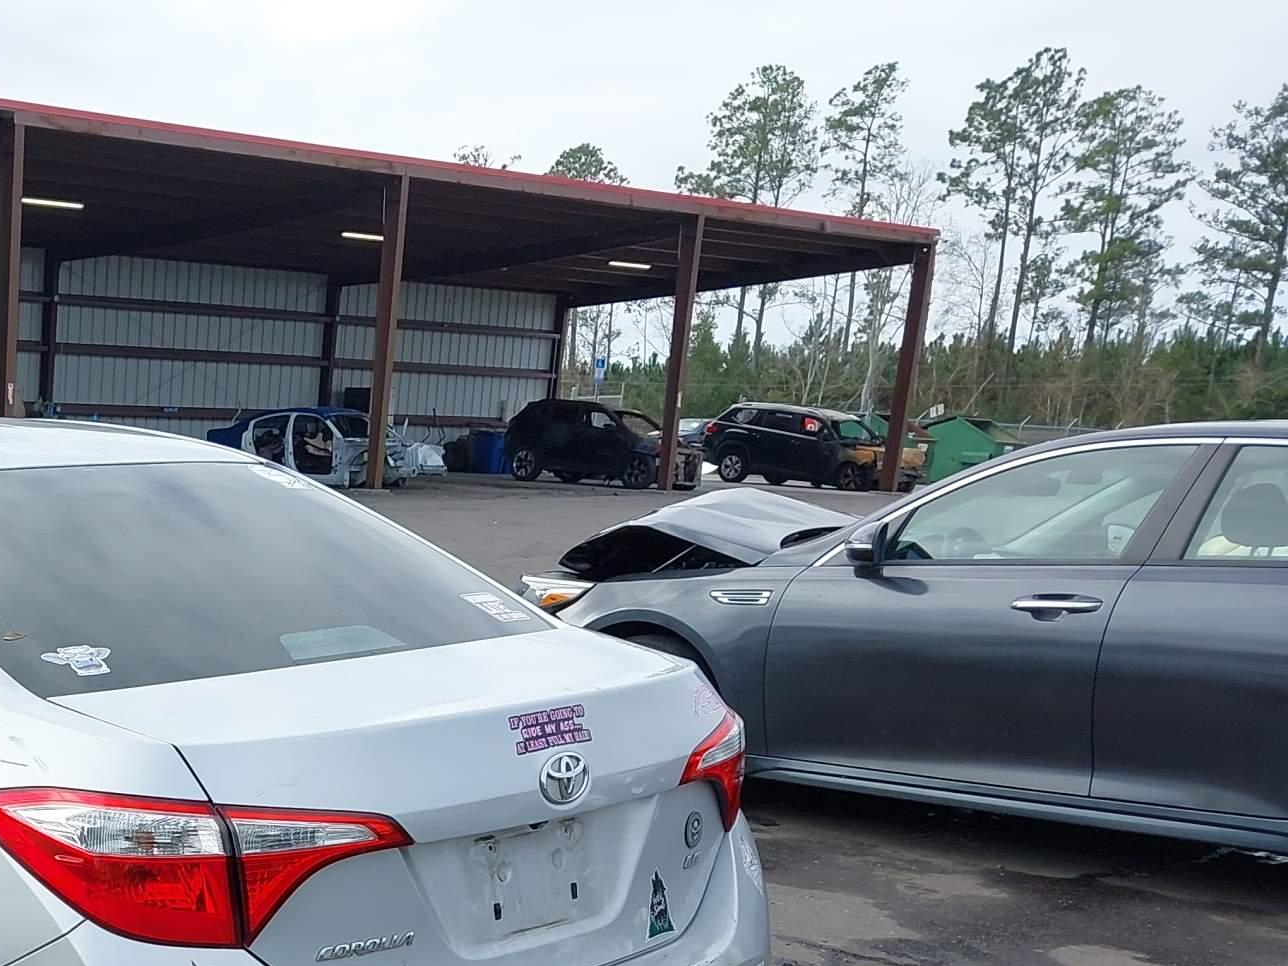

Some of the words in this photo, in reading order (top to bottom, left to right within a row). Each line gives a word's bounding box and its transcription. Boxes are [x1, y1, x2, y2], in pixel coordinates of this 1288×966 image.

[510, 717, 519, 729] IF
[520, 713, 548, 727] YOU'RE
[549, 707, 573, 720] GOING
[573, 705, 583, 717] TO
[522, 726, 542, 738] RIDE
[544, 723, 557, 734] MY
[517, 742, 526, 753] AT
[526, 738, 548, 752] LEAST
[563, 732, 574, 744] MY
[316, 931, 414, 962] COROLLA
